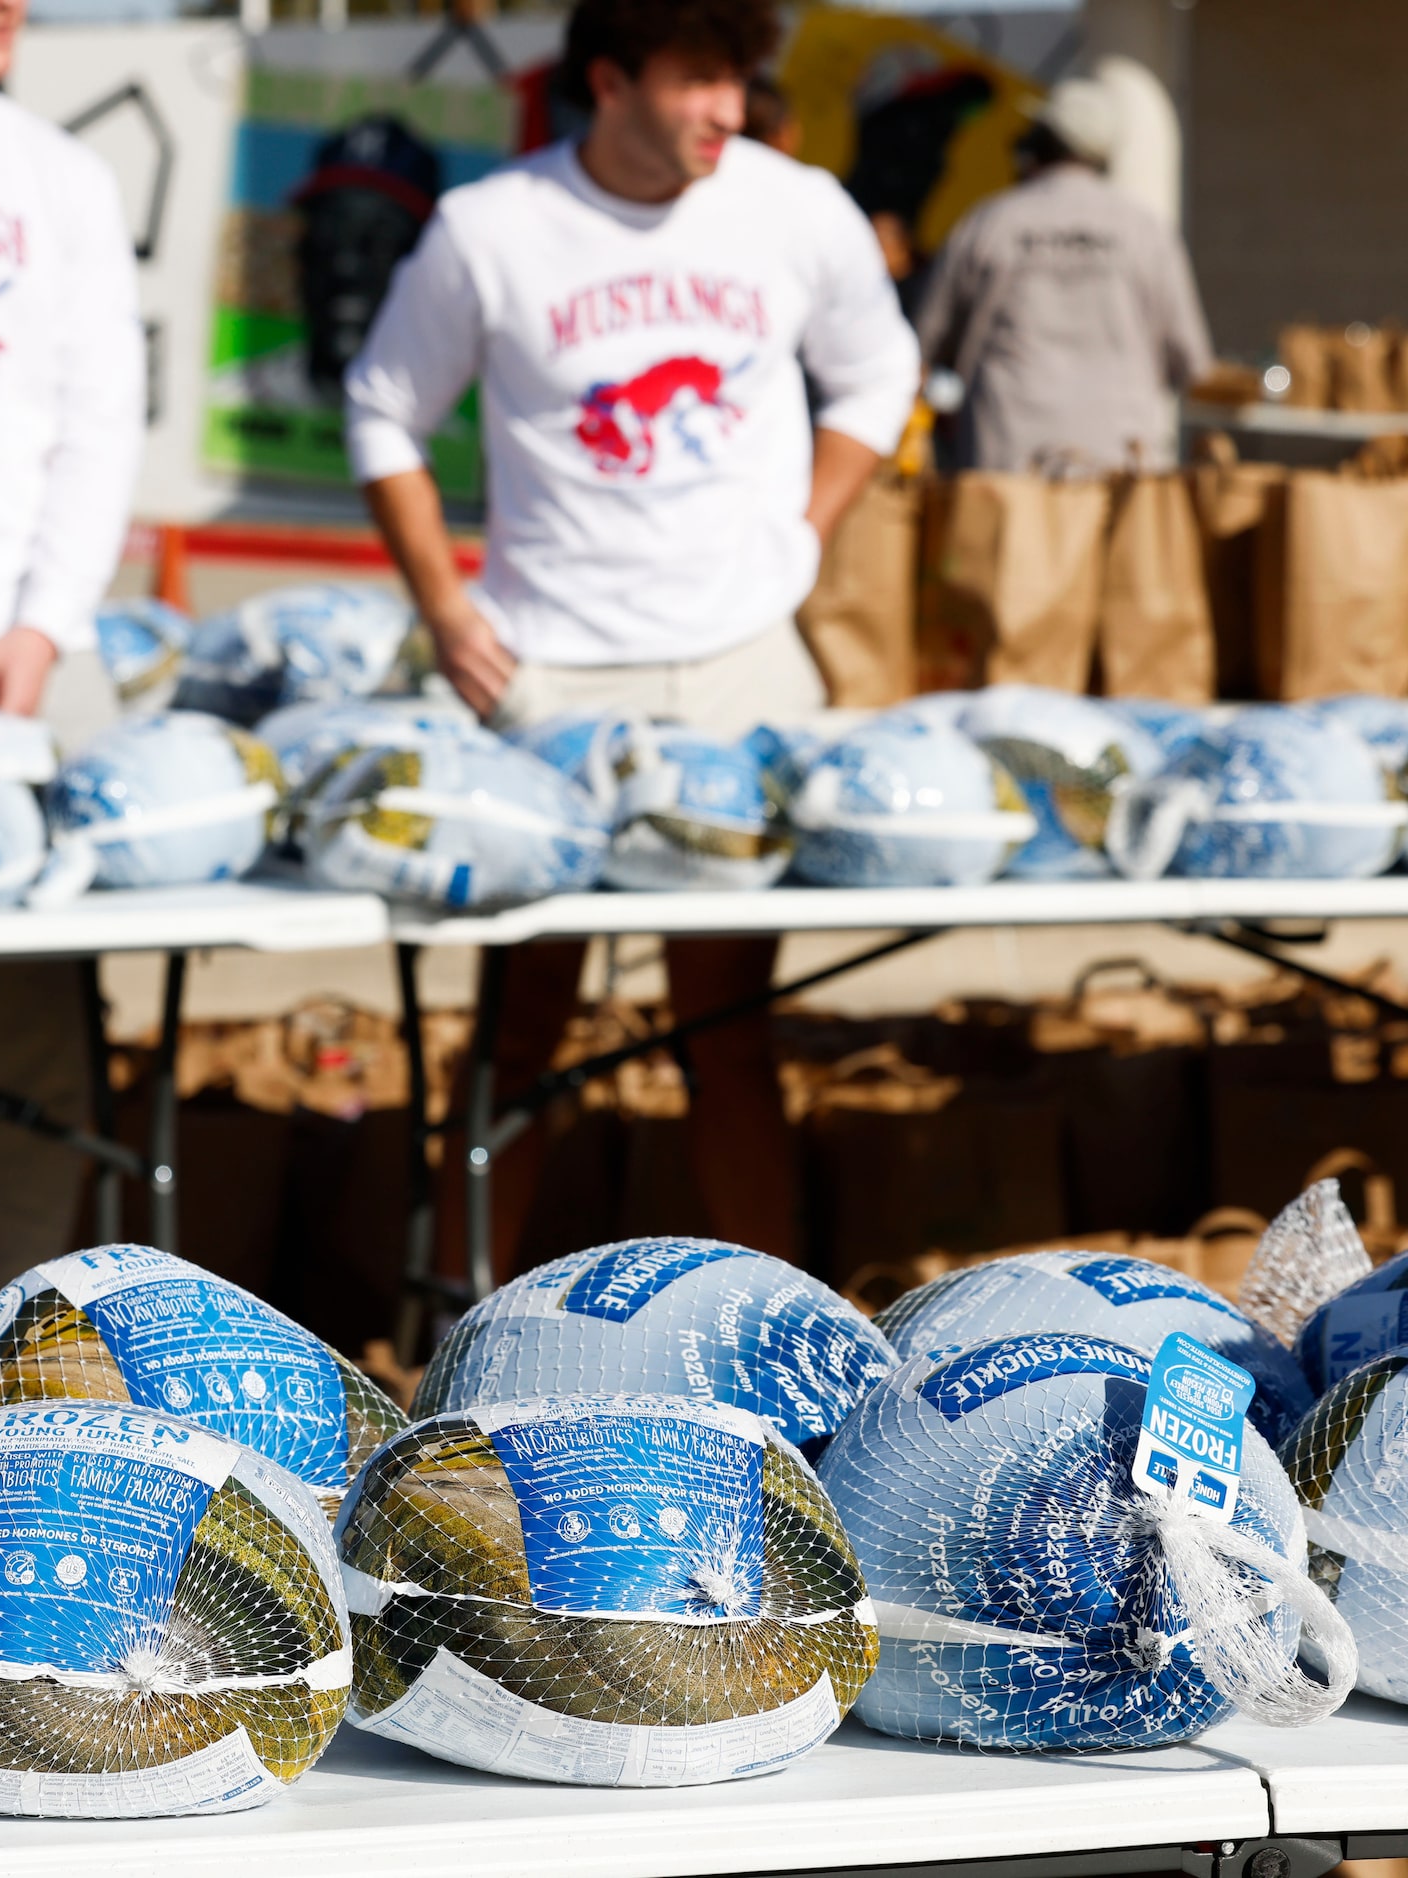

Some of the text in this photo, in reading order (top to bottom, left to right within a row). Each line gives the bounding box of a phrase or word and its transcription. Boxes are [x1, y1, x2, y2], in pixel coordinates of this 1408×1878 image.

[114, 1258, 178, 1273] YOUNG
[134, 1296, 205, 1323] ANTIBIOTICS
[718, 1288, 753, 1347] frozen
[163, 1352, 194, 1368] ADDED
[196, 1349, 247, 1362] HORMONES
[248, 1350, 263, 1360] OR
[678, 1329, 716, 1401] frozen
[945, 1343, 1152, 1405] HONEYSUCKLE
[1181, 1375, 1206, 1396] PERSON
[1169, 1379, 1229, 1413] 1 POUND OF TURKEY
[1176, 1390, 1223, 1417] USDA SUGGESTS
[1206, 1386, 1220, 1399] PER
[76, 1428, 164, 1448] TURKEY
[549, 1428, 634, 1451] ANTIBIOTICS
[644, 1426, 689, 1451] FAMILY
[692, 1436, 750, 1467] FARMERS
[677, 1420, 687, 1431] BY
[690, 1423, 750, 1451] INDEPENDENT
[1149, 1404, 1237, 1470] FROZEN
[37, 1451, 64, 1459] WITH
[73, 1453, 199, 1492] RAISED BY INDEPENDENT
[70, 1465, 192, 1514] FAMILY FARMERS
[565, 1486, 603, 1499] ADDED
[607, 1485, 670, 1497] HORMONES
[672, 1488, 687, 1498] OR
[970, 1444, 1019, 1539] frozen
[12, 1527, 78, 1542] HORMONES
[81, 1534, 98, 1546] OR
[928, 1512, 964, 1614] frozen
[117, 1577, 130, 1587] A
[909, 1643, 999, 1721] frozen
